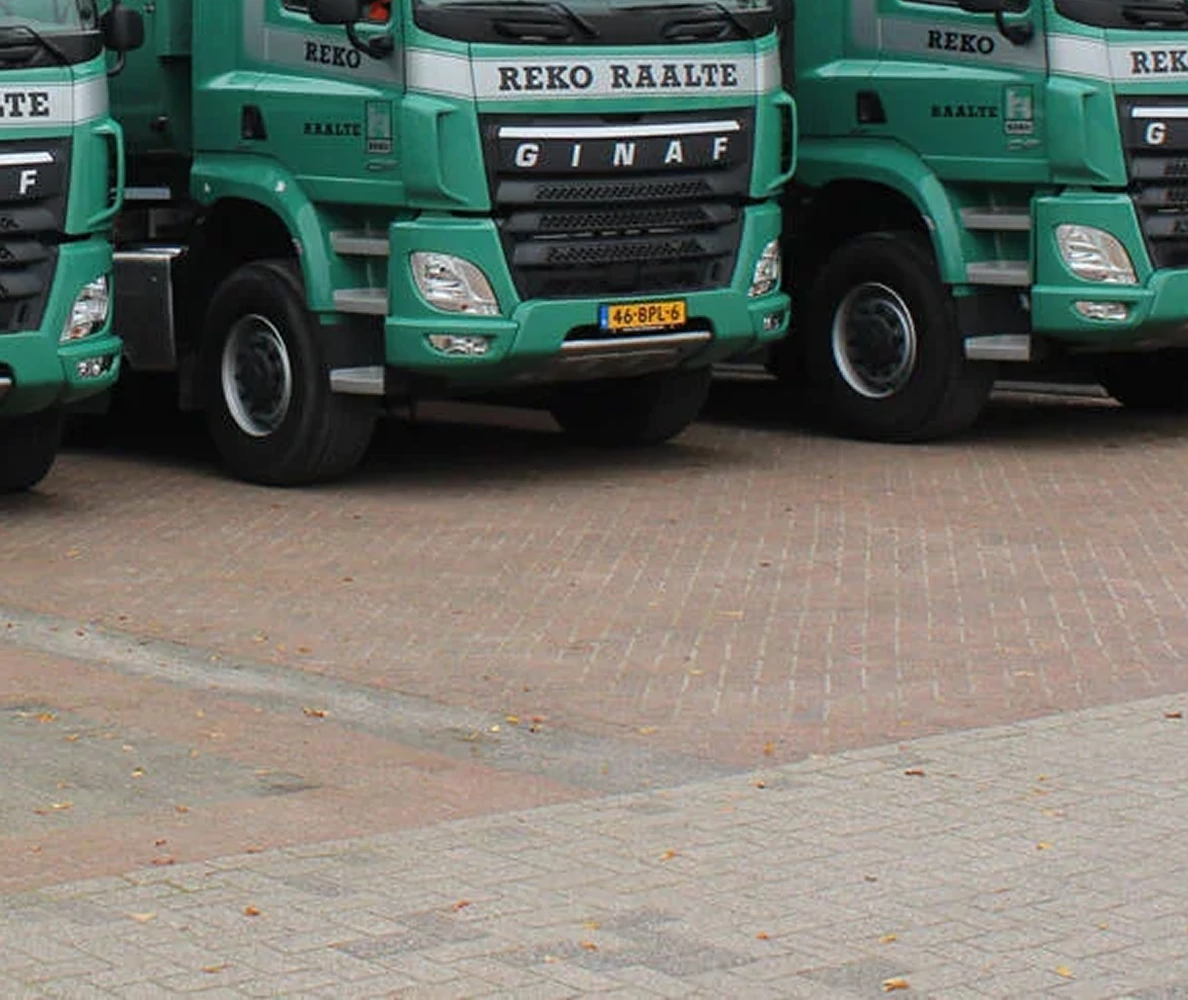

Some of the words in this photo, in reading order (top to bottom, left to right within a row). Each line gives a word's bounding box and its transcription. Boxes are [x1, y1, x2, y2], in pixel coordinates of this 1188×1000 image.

[304, 41, 362, 69] REKO
[927, 30, 996, 55] REKO
[497, 65, 593, 91] REKO
[610, 63, 738, 89] RAALTE
[930, 104, 998, 118] RAALTE
[514, 136, 729, 168] GINAF
[612, 304, 680, 325] 46-BPL-6
